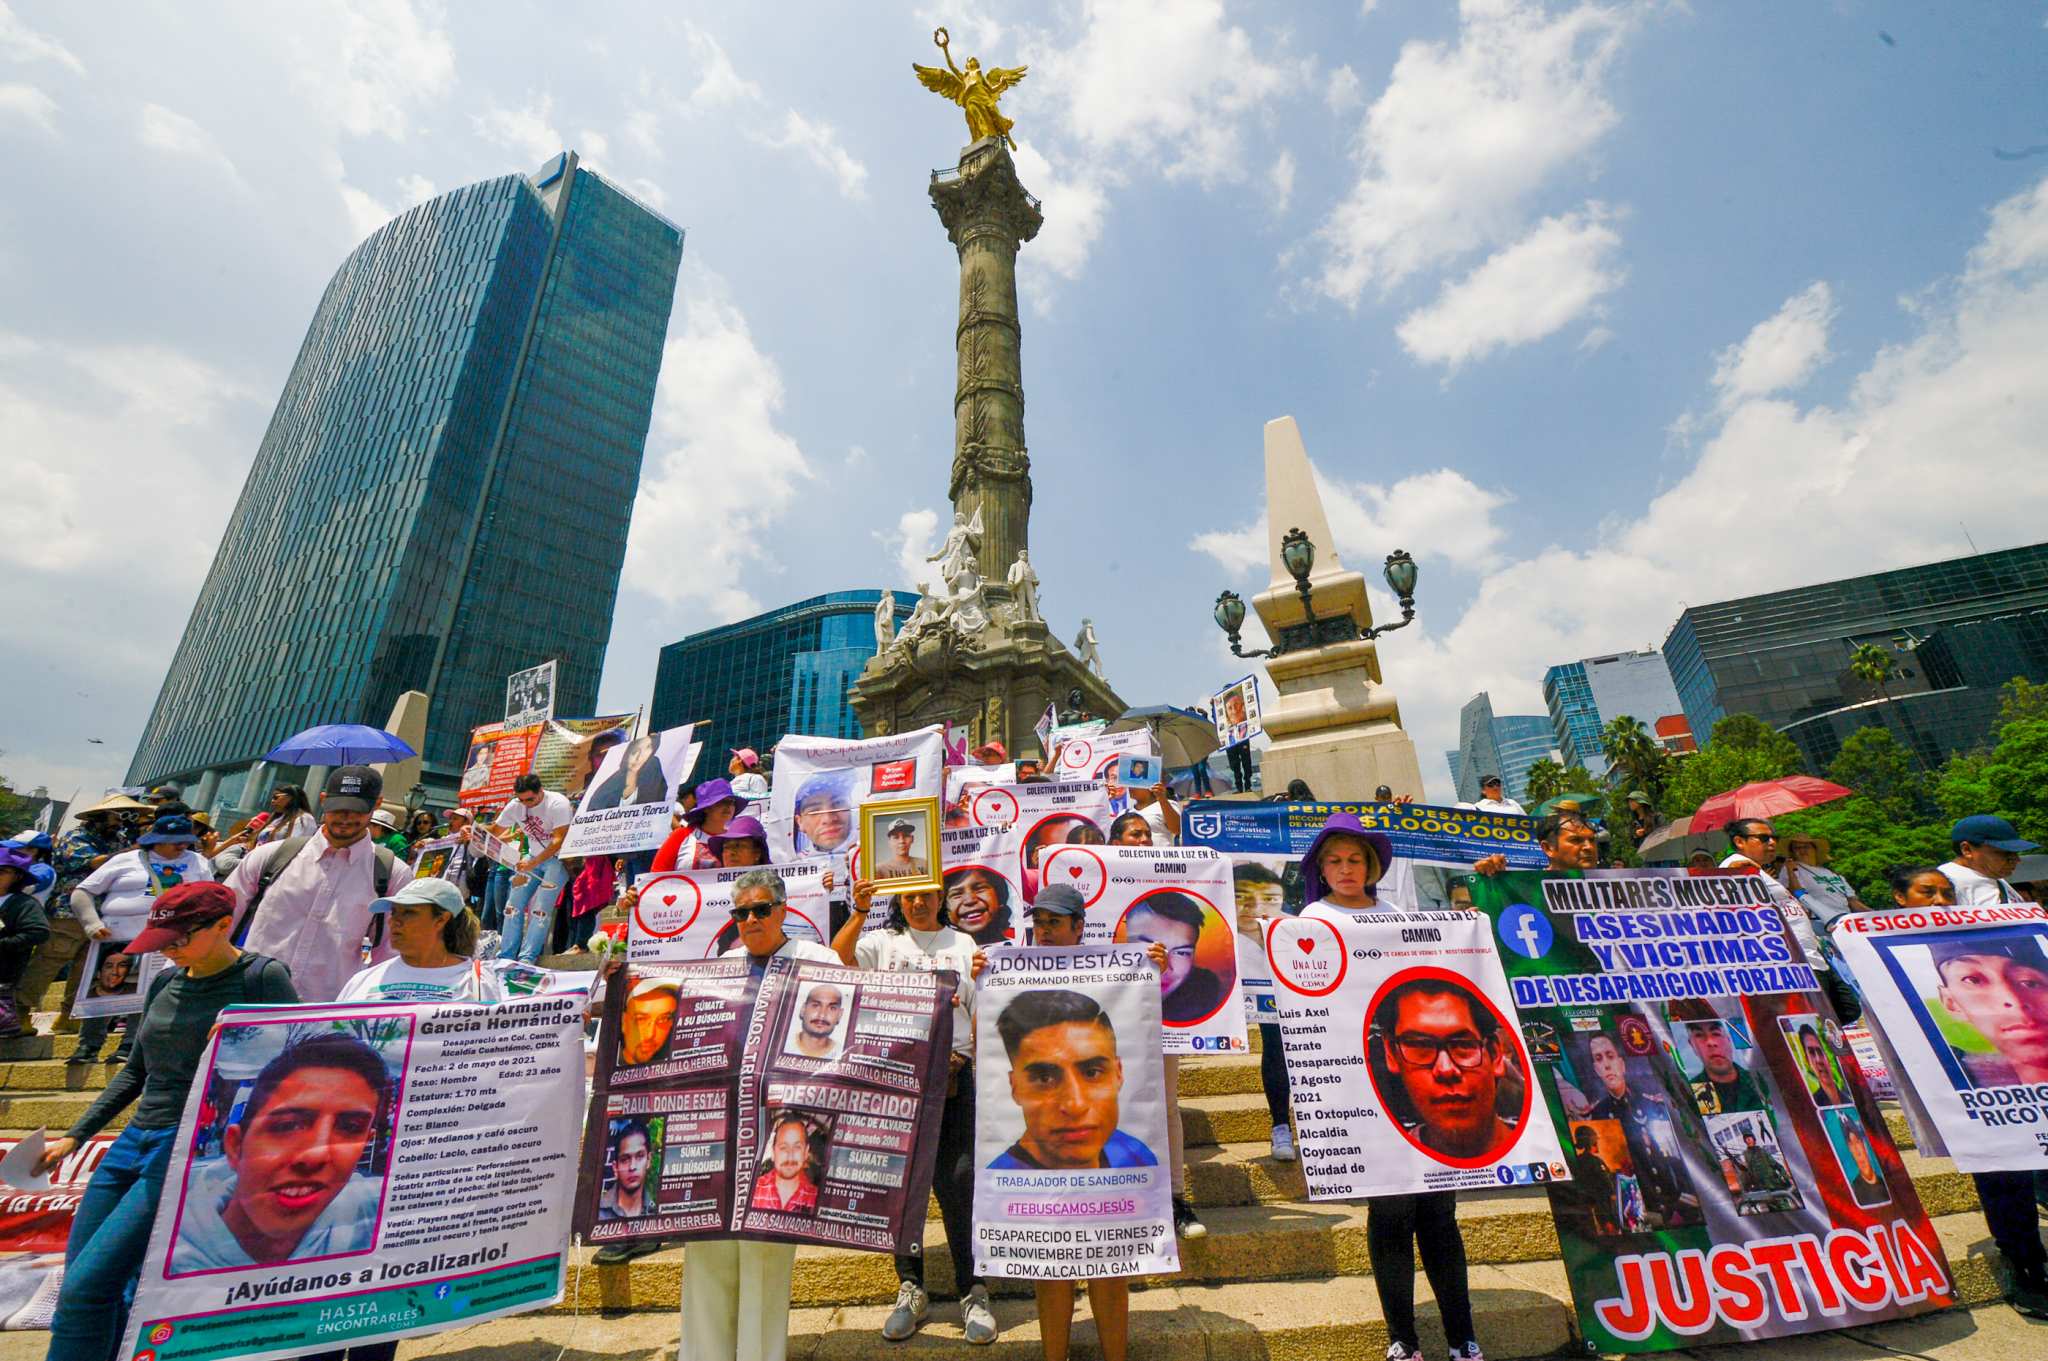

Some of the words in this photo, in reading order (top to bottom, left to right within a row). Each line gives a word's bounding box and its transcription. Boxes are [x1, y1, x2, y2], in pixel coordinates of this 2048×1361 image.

[1026, 784, 1057, 795] COLECTIVO
[1058, 784, 1071, 793] UNA
[1071, 784, 1082, 793] LUZ
[1052, 796, 1076, 804] CAMINO
[572, 814, 602, 826] Sandra
[604, 809, 639, 821] Cabrera
[642, 805, 670, 816] Flores
[1287, 804, 1403, 815] PERSONAS
[1412, 808, 1538, 829] DESAPARECI
[623, 822, 633, 830] 27
[959, 830, 974, 840] UNA
[975, 828, 988, 838] LUZ
[951, 843, 981, 856] CAMINO
[1118, 849, 1161, 859] COLECTIVO
[1163, 849, 1180, 859] UNA
[1181, 850, 1196, 859] LUZ
[1198, 851, 1209, 859] EN
[1210, 850, 1220, 859] EL
[1154, 863, 1187, 874] CAMINO
[1544, 879, 1673, 910] MILITARES
[1674, 876, 1774, 906] MUERTO
[1352, 913, 1405, 924] COLECTIVO
[1407, 913, 1430, 922] UNA
[1432, 912, 1448, 922] LUZ
[1450, 911, 1464, 921] EN
[1465, 911, 1478, 920] EL
[1577, 910, 1784, 940] ASESINADOS
[1871, 912, 1926, 931] SIGO
[1401, 928, 1442, 943] CAMINO
[631, 950, 660, 958] Eslava
[991, 955, 1068, 974] ¿DÓNDE
[1073, 950, 1143, 970] ESTÁS?
[1591, 945, 1613, 970] Y
[1617, 937, 1790, 968] VICTIMAS
[812, 969, 936, 988] DESAPARECIDO!
[1018, 976, 1070, 986] ARMANDO
[1072, 974, 1104, 983] REYES
[1106, 972, 1153, 982] ESCOBAR
[1513, 979, 1550, 1005] DE
[1556, 970, 1725, 1002] DESAPARICION
[1727, 965, 1819, 993] FORZADA
[495, 999, 574, 1016] Armando
[747, 956, 785, 1048] HERMANOS
[1278, 1009, 1301, 1019] Luis
[1305, 1008, 1329, 1017] Axel
[421, 1019, 480, 1034] García
[487, 1014, 581, 1030] Hernández
[1281, 1024, 1327, 1035] Guzmán
[1283, 1042, 1322, 1052] Zarate
[415, 1062, 447, 1073] Fecha:
[449, 1062, 454, 1070] 2
[471, 1060, 496, 1069] mayo
[498, 1058, 510, 1066] de
[512, 1056, 536, 1065] 2021
[610, 1066, 649, 1084] GUSTAVO
[651, 1060, 689, 1076] TRUJILLO
[690, 1054, 728, 1071] HERRERA
[1288, 1056, 1364, 1069] Desaparecido
[411, 1077, 439, 1088] Sexo:
[441, 1074, 478, 1085] Hombre
[499, 1070, 524, 1079] Edad:
[525, 1069, 538, 1077] 23
[540, 1066, 561, 1075] años
[775, 1055, 798, 1069] LUIS
[840, 1062, 880, 1081] TRUJILLO
[882, 1069, 920, 1090] HERRERA
[1291, 1076, 1298, 1086] 2
[1301, 1074, 1342, 1087] Agosto
[623, 1096, 650, 1114] RAUL
[654, 1094, 690, 1111] DONDE
[737, 1051, 758, 1140] TRUJILLO
[782, 1086, 918, 1119] DESAPARECIDO!
[1293, 1093, 1322, 1103] 2021
[406, 1106, 465, 1118] Complexión:
[468, 1100, 506, 1113] Delgada
[1296, 1111, 1311, 1121] En
[1315, 1107, 1378, 1121] Oxtopulco,
[404, 1123, 423, 1132] Tez:
[425, 1119, 459, 1130] Blanco
[837, 1114, 866, 1127] ATOYAC
[867, 1118, 877, 1128] DE
[880, 1120, 913, 1134] ALVAREZ
[400, 1137, 425, 1148] Ojos:
[428, 1133, 474, 1145] Medianos
[476, 1133, 482, 1141] y
[484, 1127, 505, 1138] café
[507, 1125, 538, 1135] oscuro
[1302, 1145, 1362, 1159] Coyoacan
[827, 1167, 835, 1178] A
[835, 1169, 849, 1180] SU
[850, 1167, 902, 1187] BÚSQUEDA
[1305, 1163, 1348, 1177] Ciudad
[1350, 1162, 1365, 1173] de
[996, 1176, 1068, 1187] TRABAJADOR
[1070, 1176, 1085, 1186] DE
[1087, 1173, 1149, 1186] SANBORNS
[1309, 1182, 1353, 1196] México
[1007, 1199, 1136, 1216] #TEBUSCAMOSJESÚS
[591, 1224, 624, 1238] RAUL
[627, 1218, 673, 1232] TRUJILLO
[674, 1212, 722, 1226] HERRERA
[768, 1214, 812, 1232] SALVADOR
[813, 1220, 852, 1240] TRUJILLO
[854, 1229, 895, 1247] HERRERA
[979, 1228, 1072, 1243] DESAPARECIDO
[1075, 1230, 1091, 1242] EL
[1094, 1226, 1148, 1241] VIERNES
[1150, 1225, 1165, 1237] 29
[990, 1246, 1006, 1258] DE
[1009, 1246, 1083, 1260] NOVIEMBRE
[1086, 1246, 1104, 1258] DE
[1106, 1244, 1134, 1257] 2019
[1138, 1243, 1154, 1255] EN
[225, 1270, 352, 1304] ¡Ayúdanos
[359, 1270, 373, 1283] a
[380, 1242, 509, 1280] localizarlo!
[1111, 1262, 1140, 1274] GAM
[1599, 1223, 1945, 1335] JUSTICIA
[320, 1301, 378, 1321] HASTA
[316, 1309, 418, 1335] ENCONTRARLES
